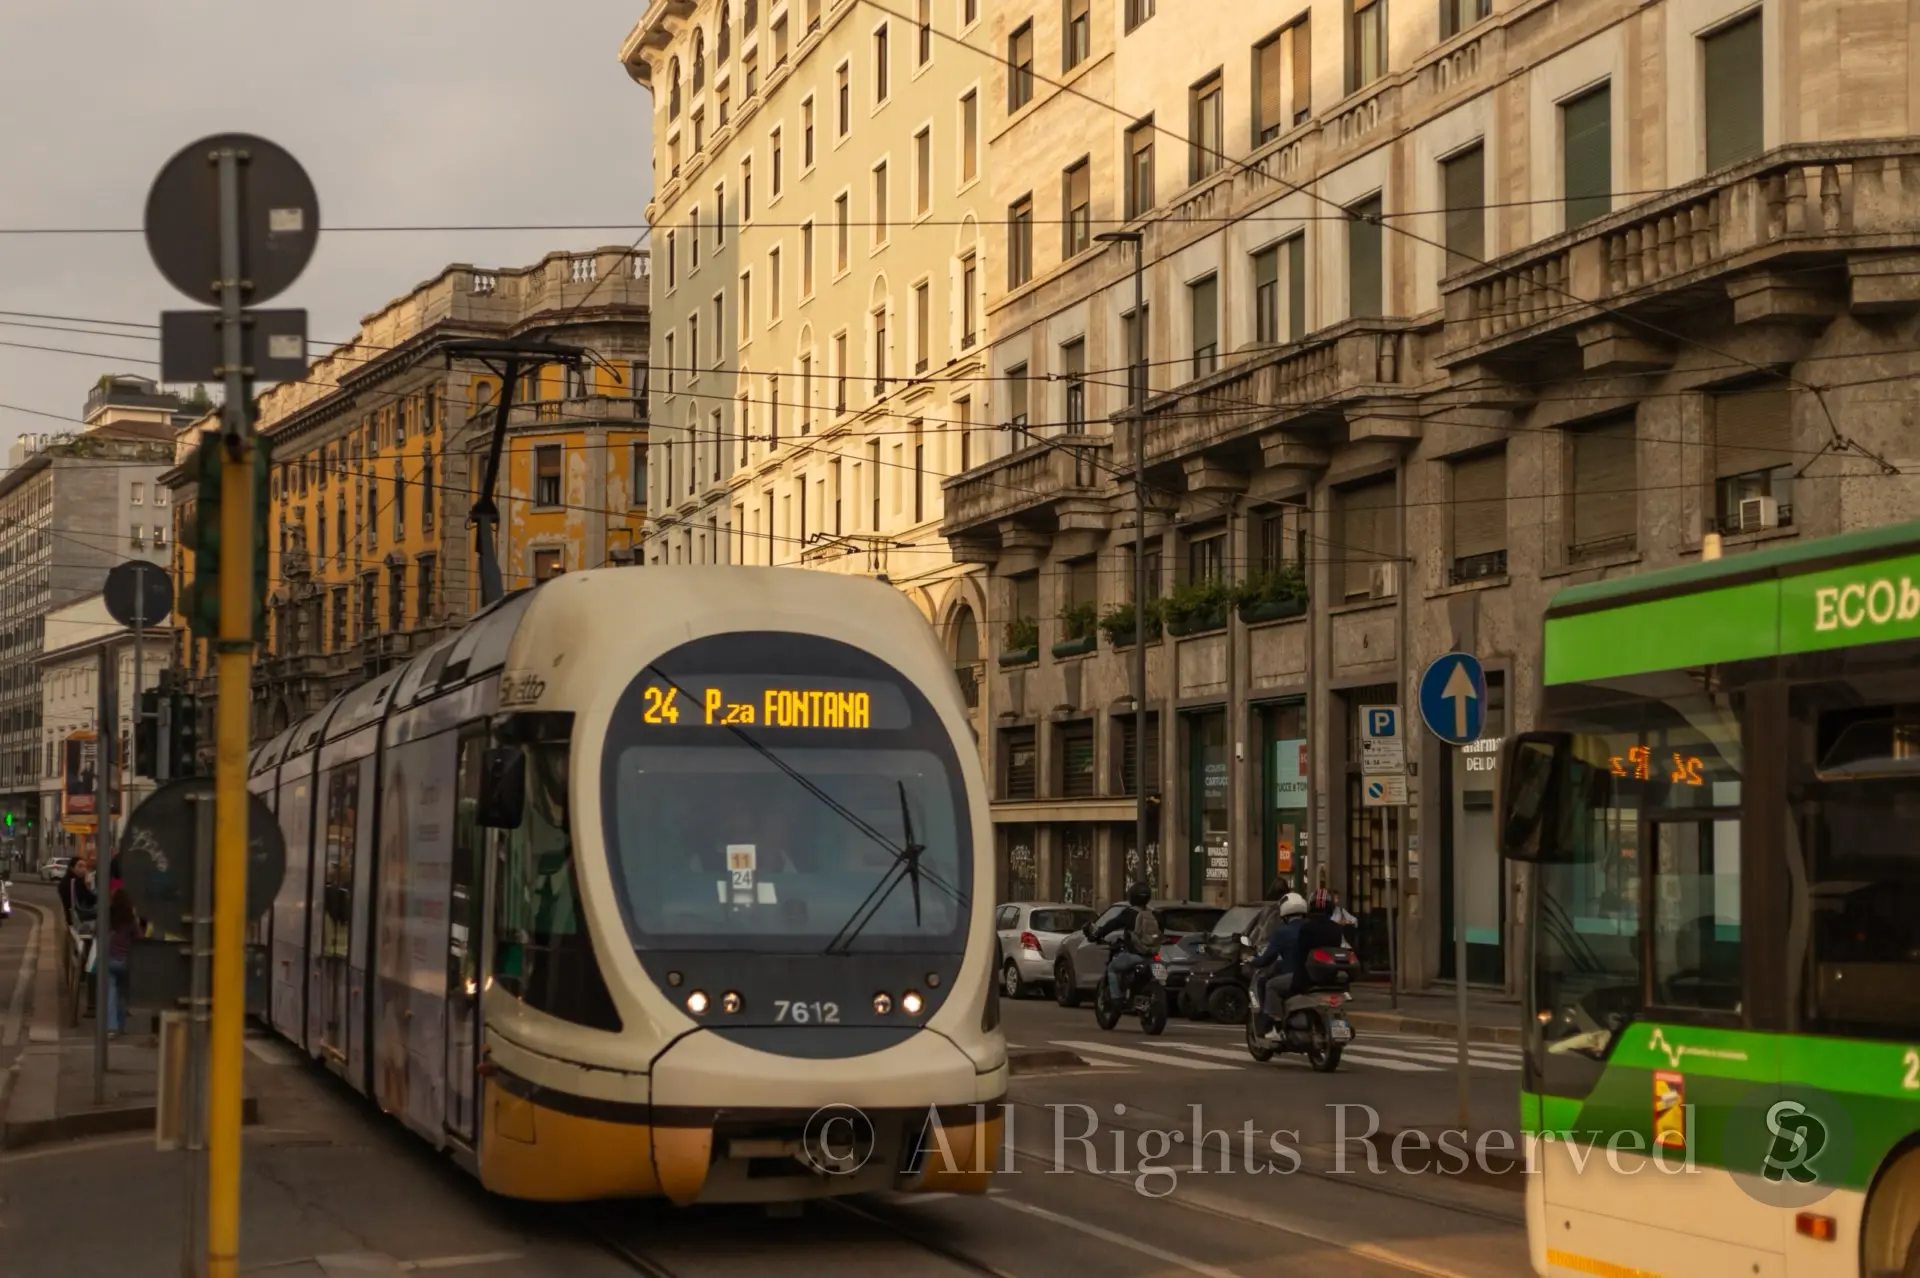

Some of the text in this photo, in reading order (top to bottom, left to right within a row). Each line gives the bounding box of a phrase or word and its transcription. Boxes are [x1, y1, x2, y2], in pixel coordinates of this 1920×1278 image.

[643, 687, 869, 728] 24 P.za FONTANA
[1374, 712, 1390, 734] P
[1466, 757, 1484, 771] DEL
[733, 870, 751, 886] 24
[774, 1000, 841, 1024] 7612
